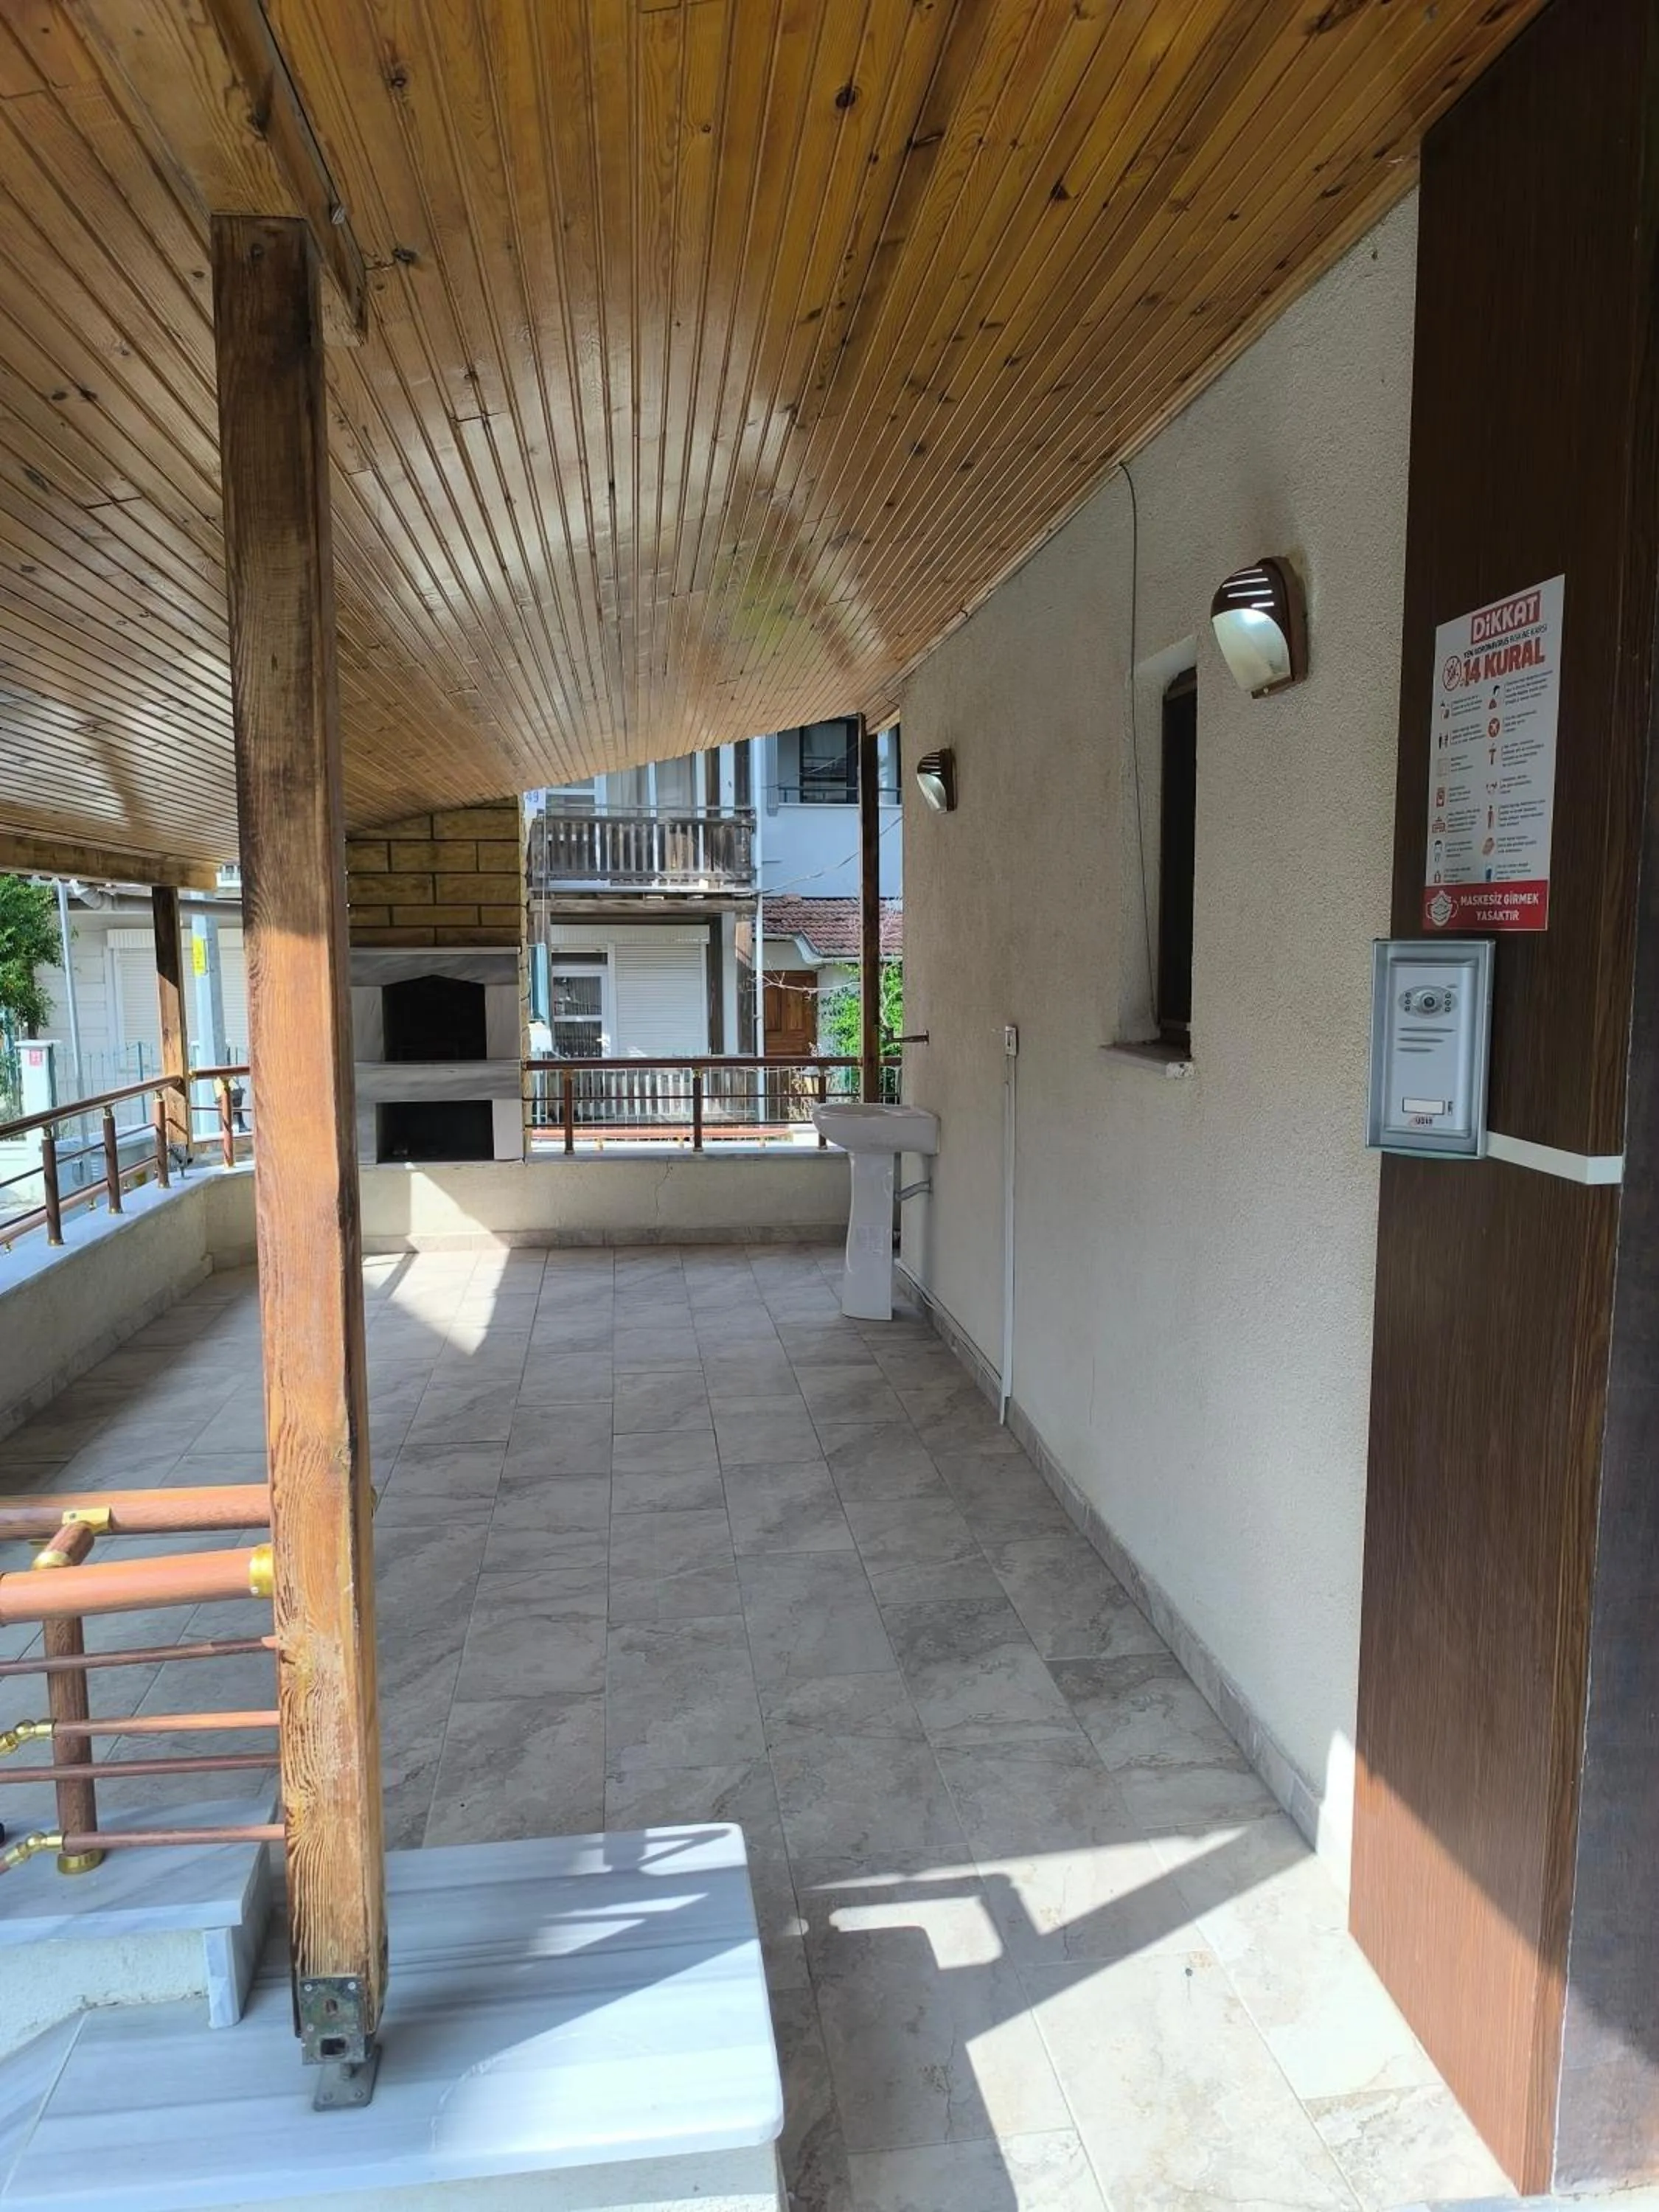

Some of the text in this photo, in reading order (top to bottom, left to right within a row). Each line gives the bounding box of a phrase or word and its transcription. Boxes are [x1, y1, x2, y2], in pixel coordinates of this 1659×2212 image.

[1464, 656, 1481, 687] 14
[1484, 637, 1545, 679] KURAL
[1461, 891, 1539, 906] MASKESİZ GİRMEK
[1476, 910, 1520, 921] YASAKTIR
